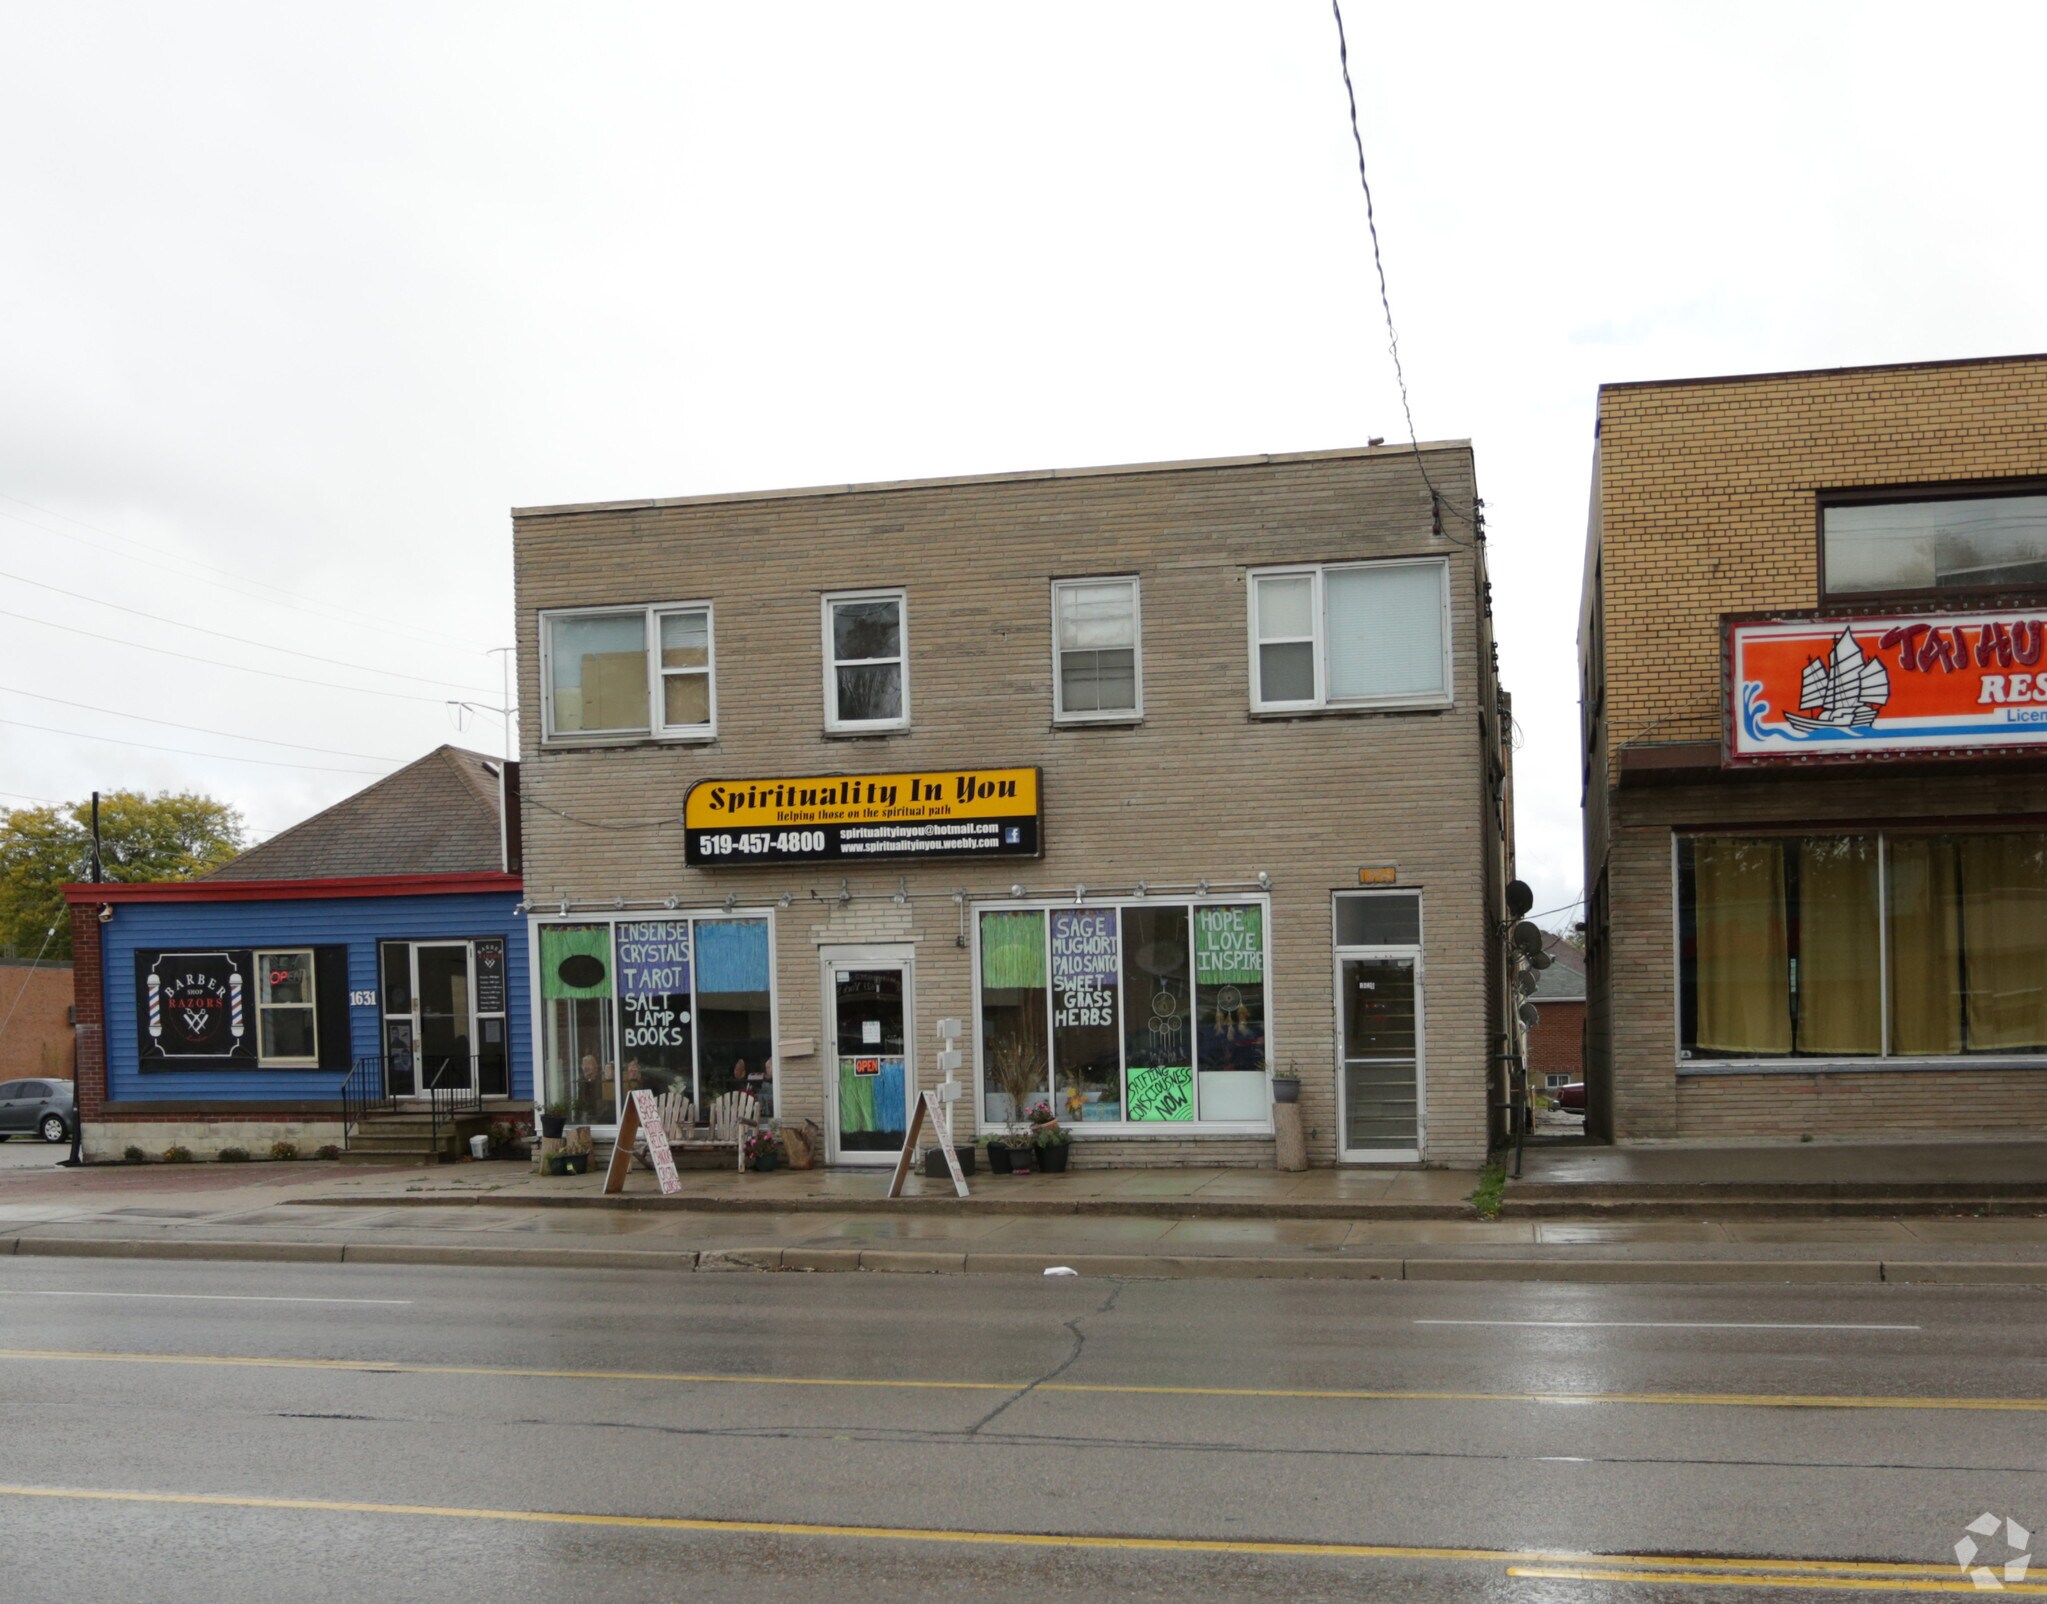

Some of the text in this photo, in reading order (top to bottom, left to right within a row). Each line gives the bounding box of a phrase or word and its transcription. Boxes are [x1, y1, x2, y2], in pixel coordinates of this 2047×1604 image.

[709, 776, 1017, 813] Spirituality In You
[777, 805, 951, 822] Helping those on the spiritual path
[840, 823, 999, 840] spiritualityinyou@hotmail.com
[700, 831, 826, 855] 519-457-4800
[841, 838, 999, 853] www.spiritualityinyou.weebly.com
[1056, 917, 1106, 938] SAGE
[1201, 909, 1245, 931] HOPE
[618, 922, 688, 942] INSENSE
[1207, 931, 1256, 951] LOVE
[620, 942, 690, 963] CRYSTALS
[1052, 936, 1117, 955] MUGWORT
[1197, 951, 1263, 971] INSPIRE
[165, 973, 227, 998] BARBER
[623, 967, 682, 989] TAROT
[1053, 974, 1105, 992] SWEET
[168, 998, 223, 1009] RAZORS
[350, 991, 377, 1006] 1631
[625, 991, 671, 1011] SALT
[1064, 991, 1112, 1008] GRASS
[635, 1011, 675, 1027] LAMP
[1055, 1008, 1112, 1028] HERBS
[625, 1027, 683, 1047] BOOKS
[856, 1059, 878, 1073] OPEN
[1128, 1066, 1170, 1104] SHIFTING
[1129, 1067, 1192, 1121] CONSCIOUSNESS
[1155, 1085, 1188, 1121] NOW
